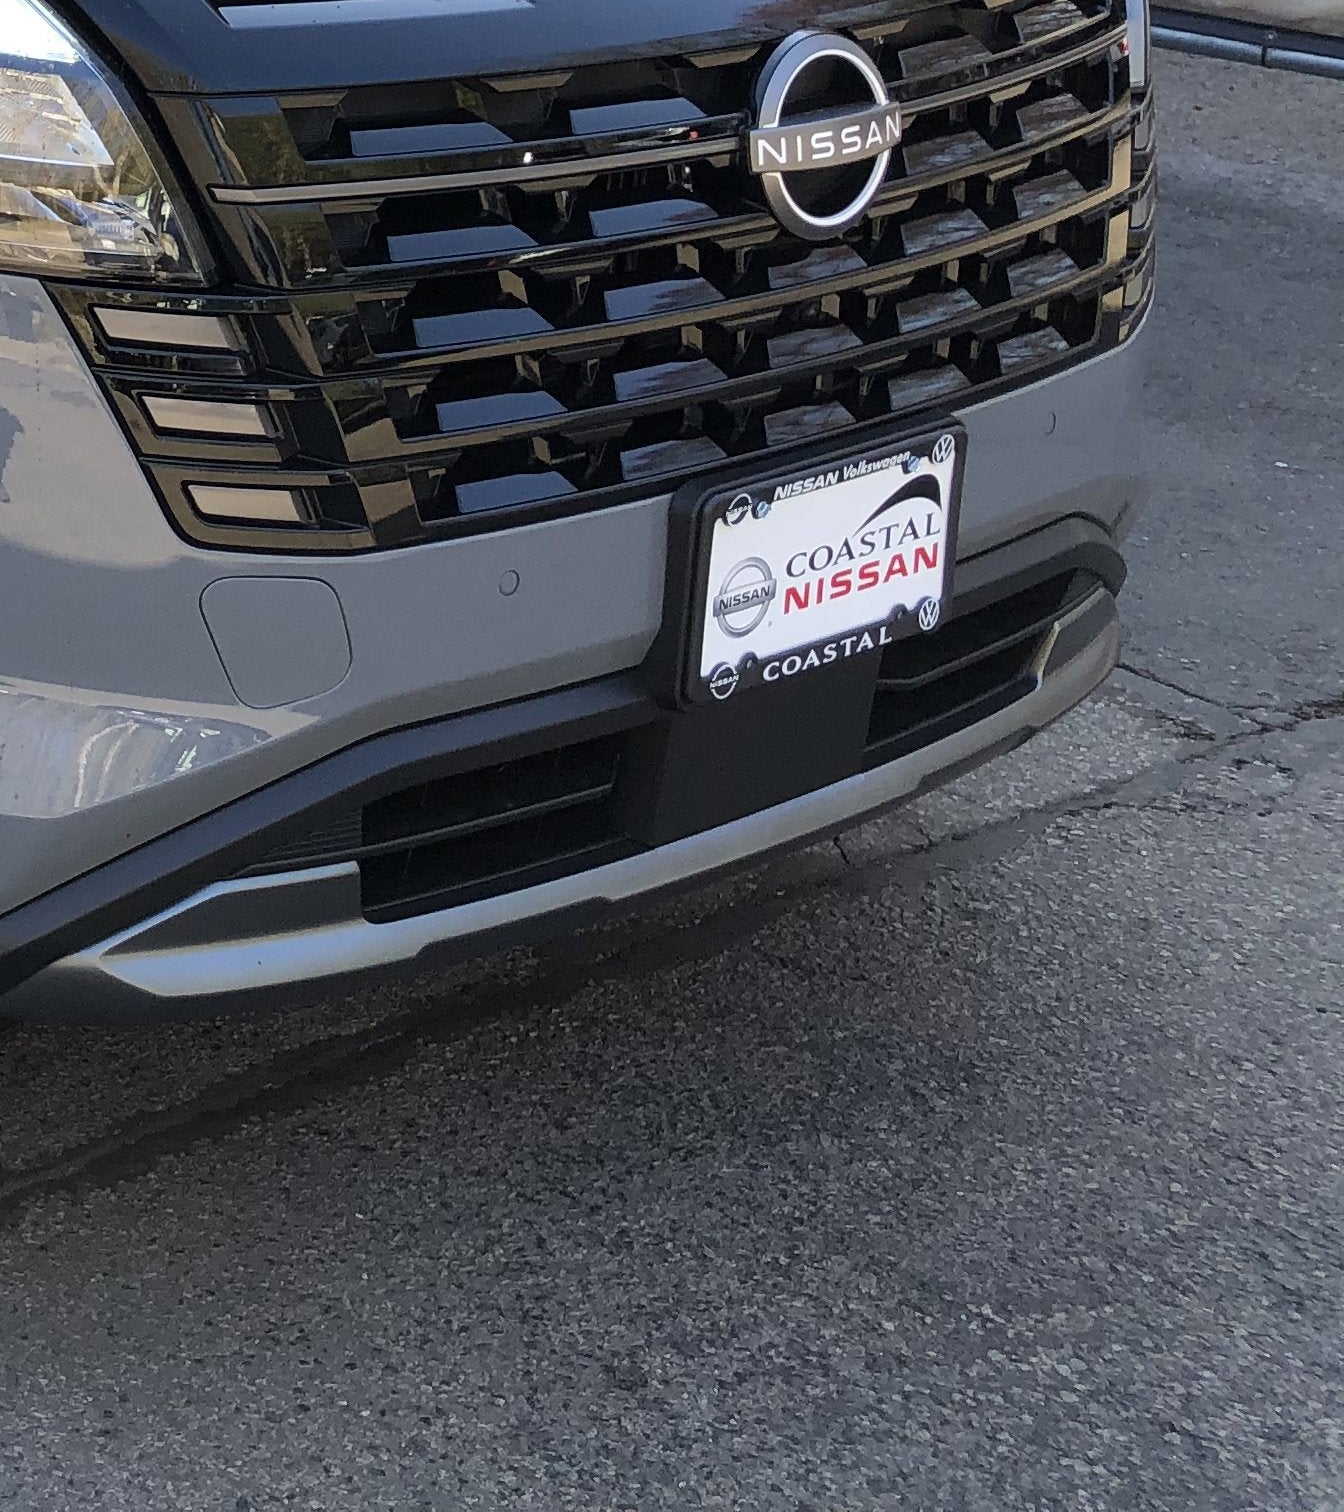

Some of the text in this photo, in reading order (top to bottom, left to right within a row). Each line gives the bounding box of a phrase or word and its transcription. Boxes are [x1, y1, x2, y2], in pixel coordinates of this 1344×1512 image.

[757, 110, 901, 166] NISSAN
[773, 450, 911, 501] NISSAN Volkswagen
[786, 512, 941, 579] COASTAL
[718, 584, 771, 611] NISSAN
[783, 542, 939, 616] NISSAN
[762, 626, 893, 682] COASTAL
